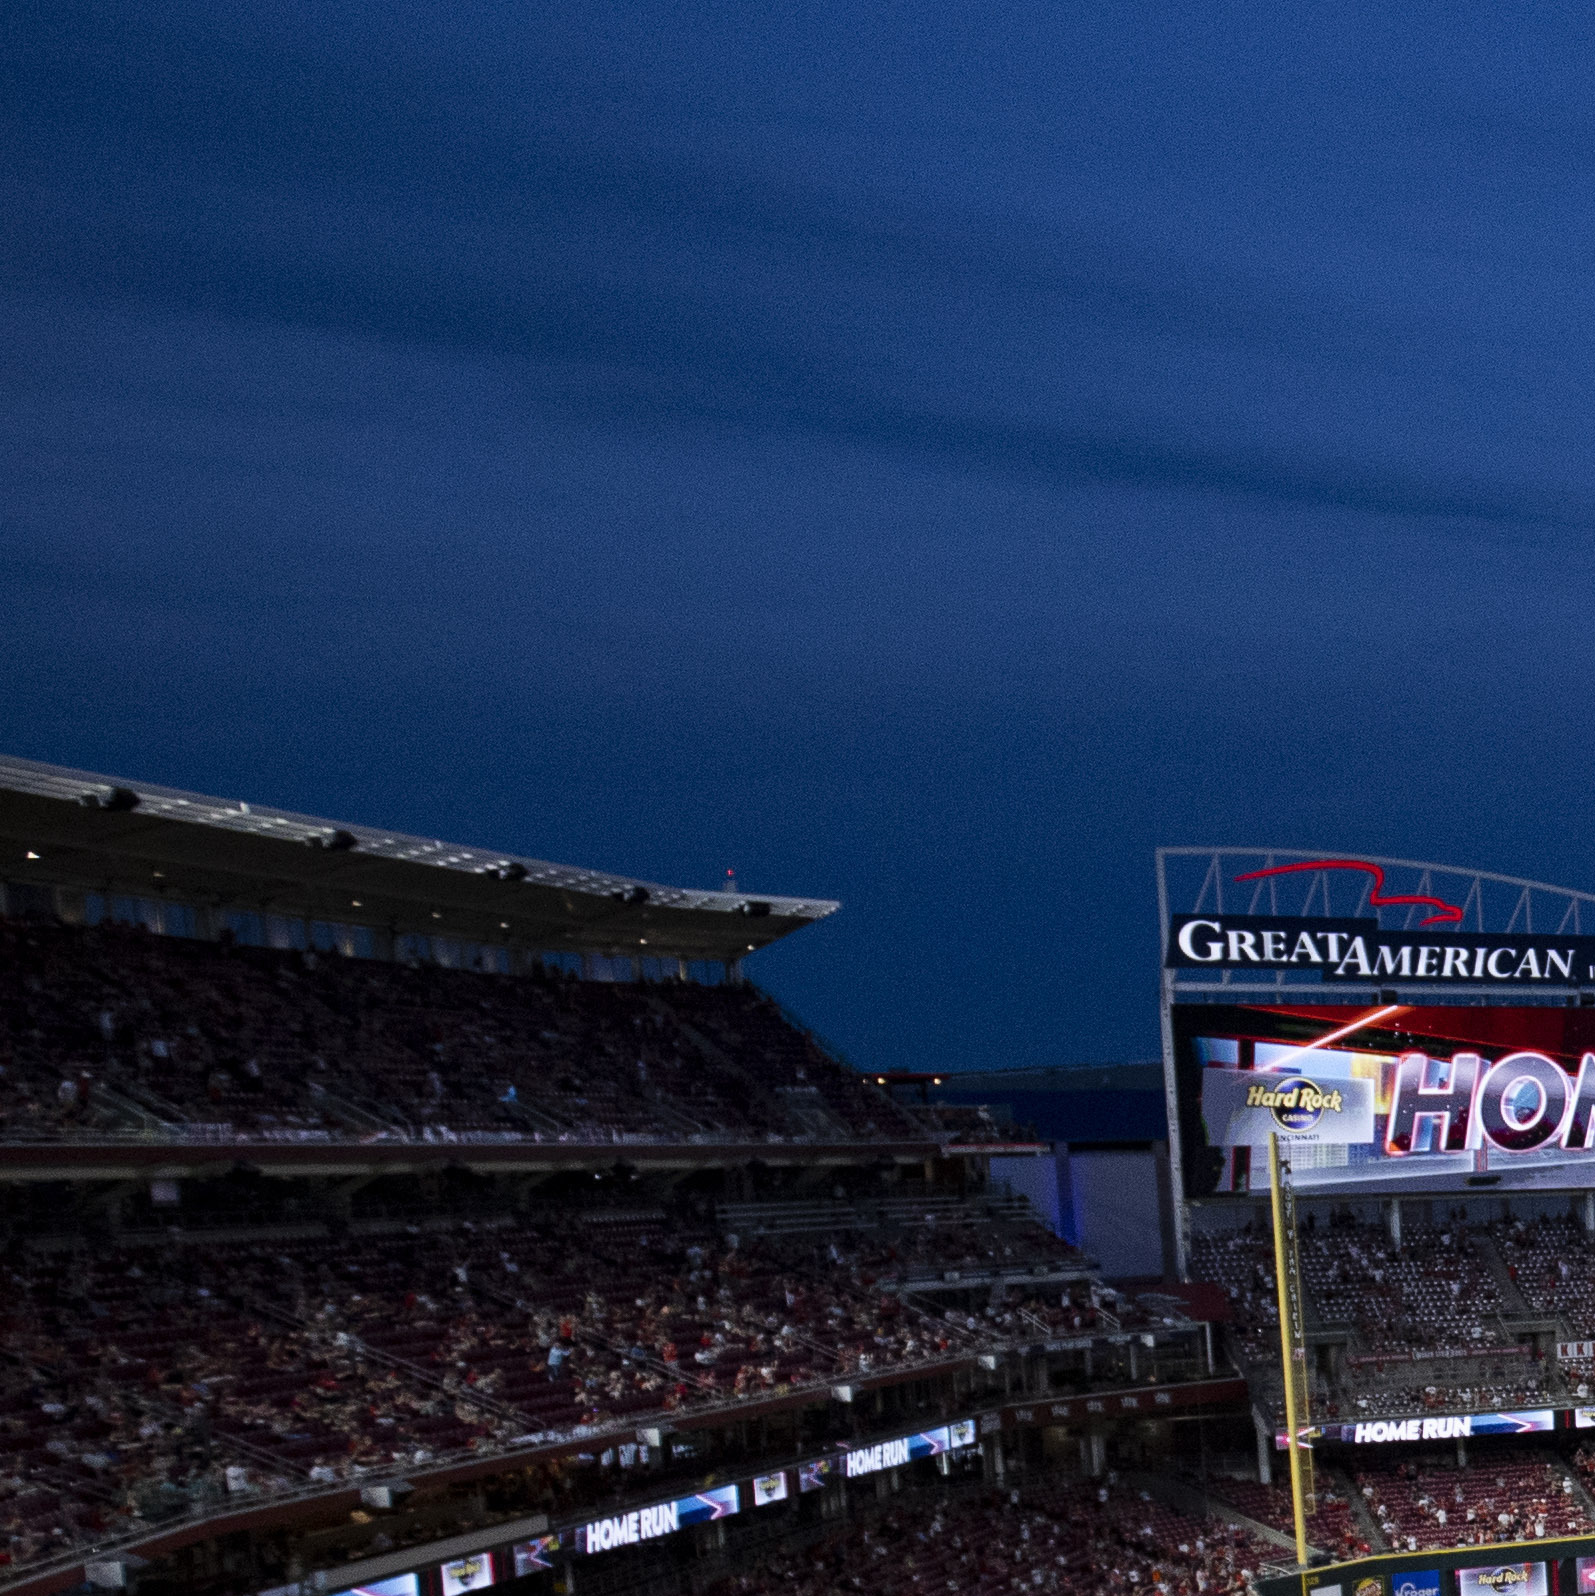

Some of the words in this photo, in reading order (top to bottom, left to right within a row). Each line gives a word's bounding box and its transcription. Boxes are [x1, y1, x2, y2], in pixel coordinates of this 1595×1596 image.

[1246, 1085, 1297, 1109] Hard
[1298, 1087, 1343, 1113] Rock
[1354, 1418, 1422, 1443] HOME
[1422, 1416, 1472, 1439] RUN
[846, 1445, 882, 1478] HOME
[882, 1437, 909, 1470] RUN
[586, 1515, 640, 1554] HOME
[639, 1502, 678, 1539] RUN
[1478, 1571, 1504, 1585] Hard
[1503, 1569, 1529, 1583] Rock
